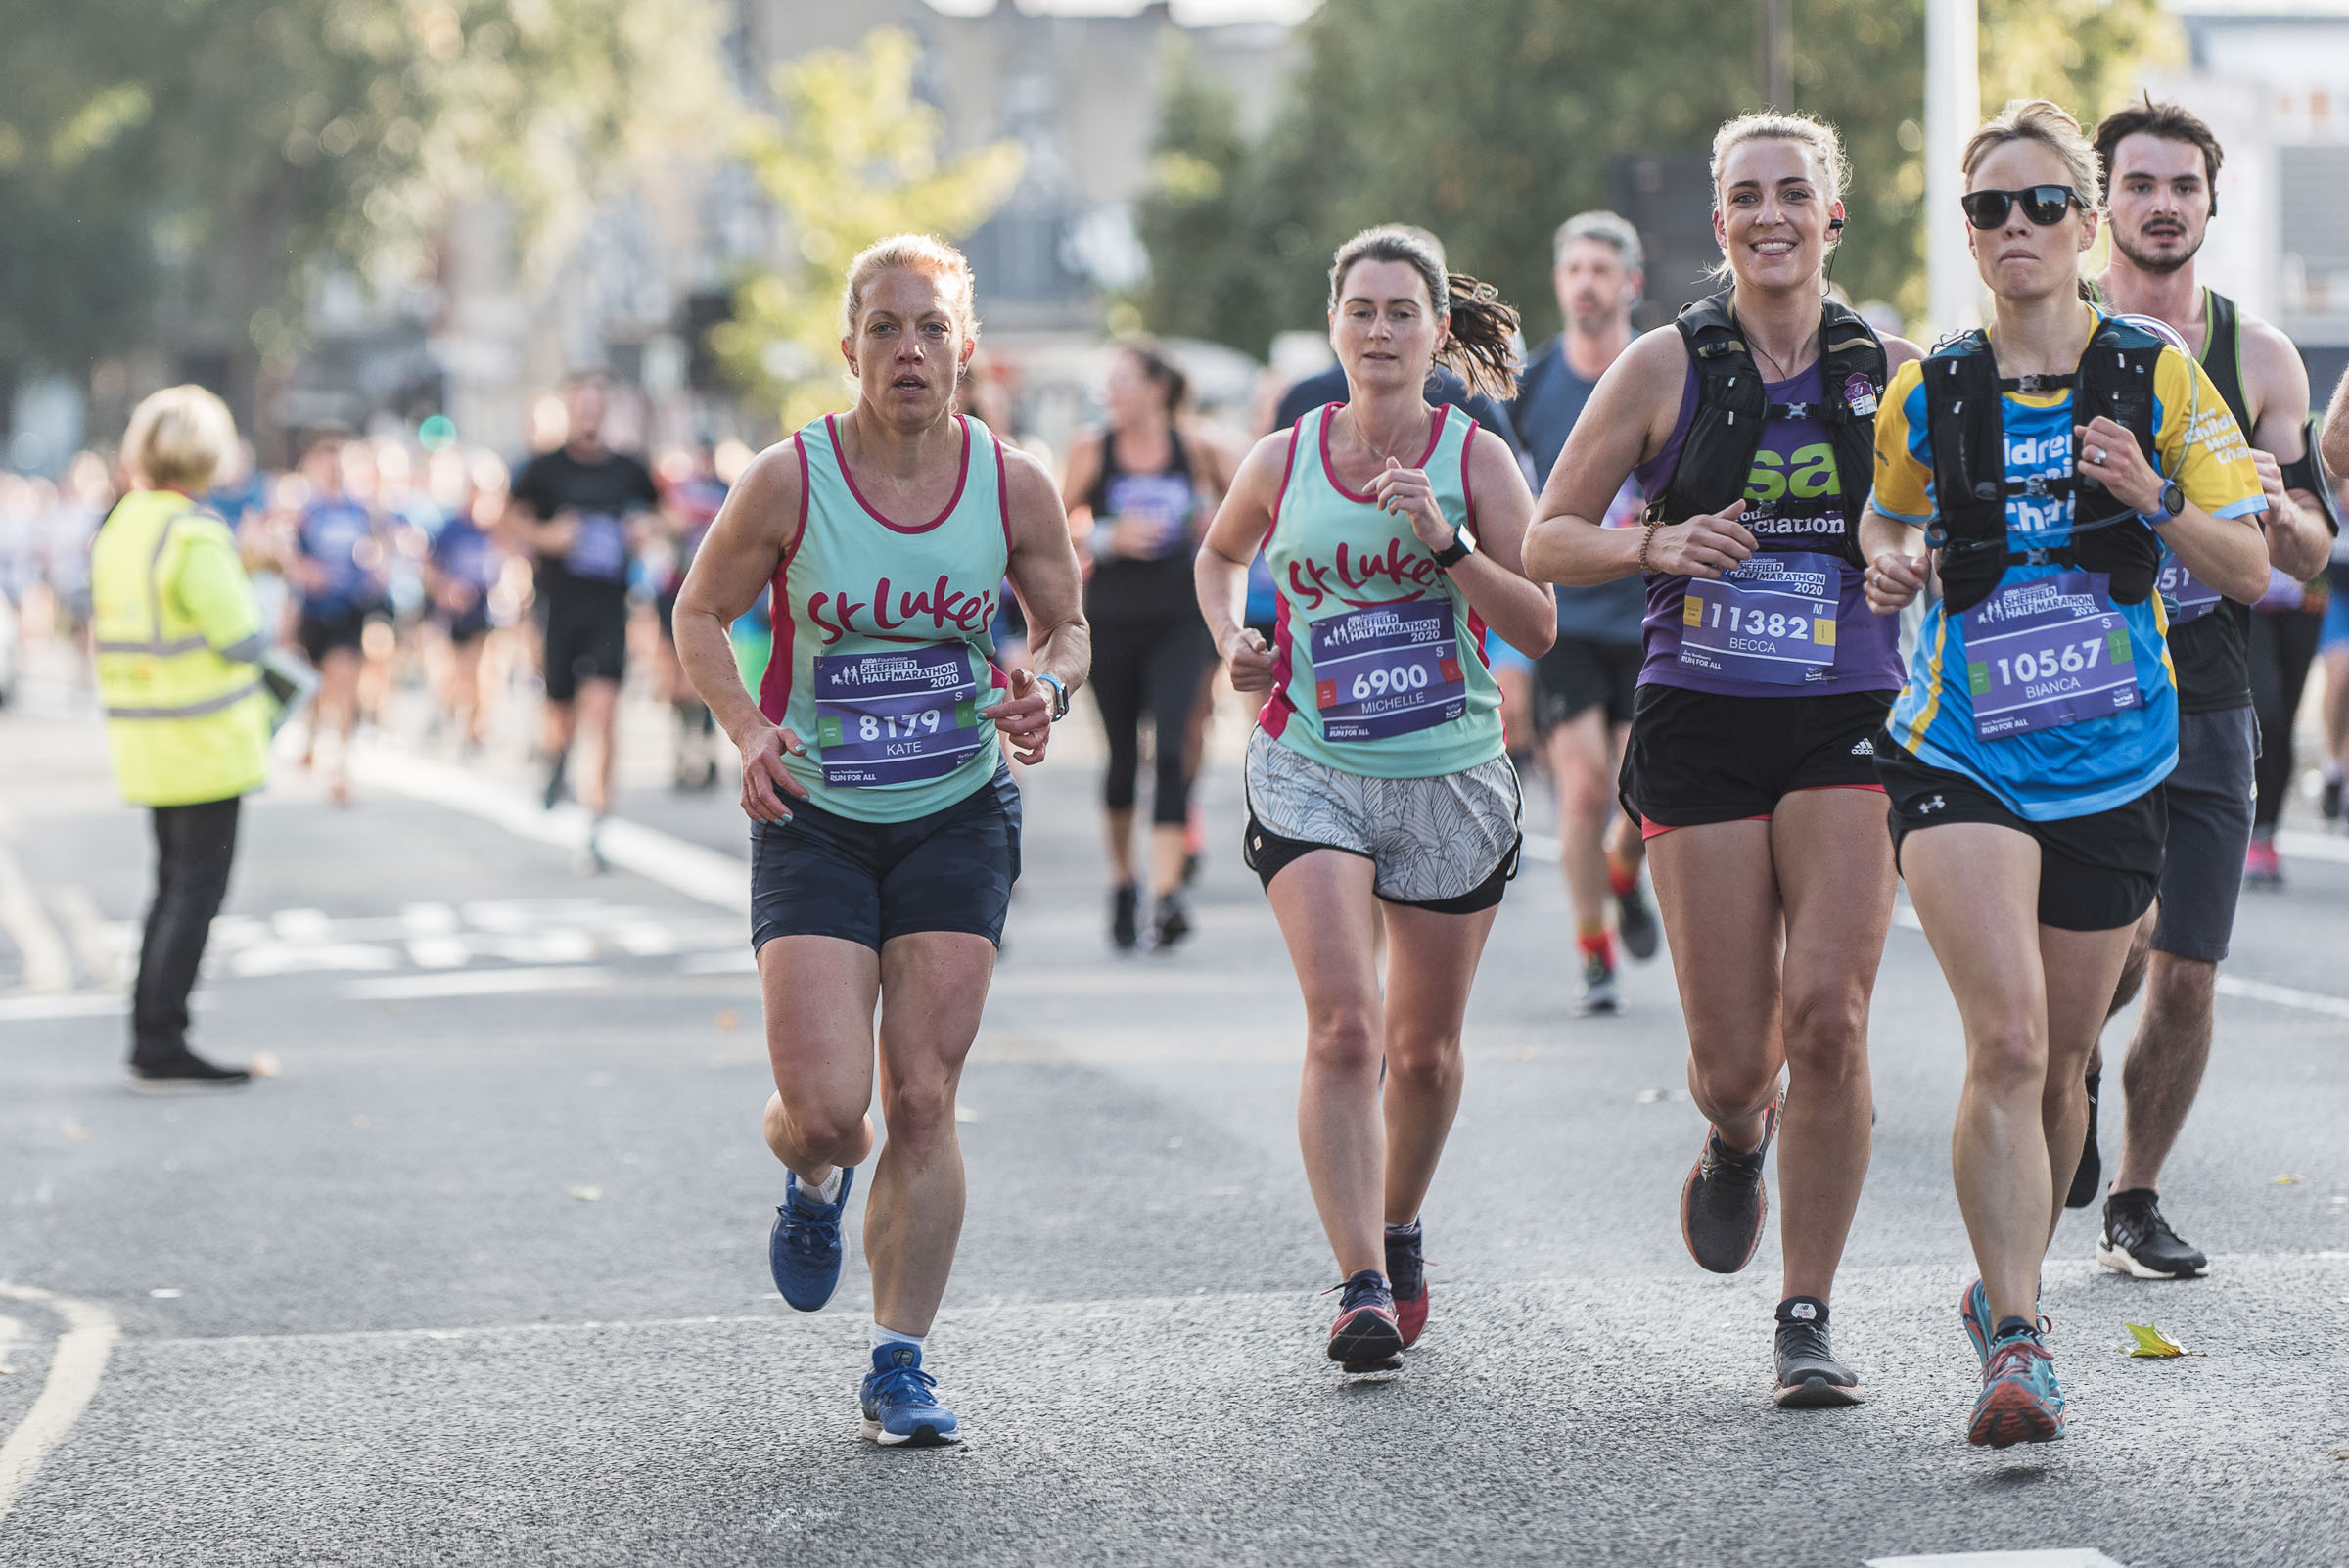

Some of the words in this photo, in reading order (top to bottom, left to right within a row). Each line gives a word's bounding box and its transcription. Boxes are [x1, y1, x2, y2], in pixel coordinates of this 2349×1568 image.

[1289, 558, 1334, 610] St
[1336, 537, 1448, 589] Luke
[1759, 573, 1825, 585] MARATHON
[2153, 567, 2190, 590] 51
[1793, 583, 1823, 595] 2020
[2004, 588, 2055, 606] SHEFFIELD
[808, 591, 866, 645] St
[873, 575, 995, 634] Luke's
[1813, 603, 1823, 615] M
[2006, 605, 2034, 619] HALF
[2036, 595, 2094, 613] MARATHON
[2072, 605, 2100, 617] 2020
[1349, 615, 1397, 630] SHEFFIELD
[1711, 603, 1808, 640] 11382
[2102, 618, 2112, 629] S
[1351, 629, 1376, 642] HALF
[1377, 620, 1439, 635] MARATHON
[1411, 630, 1440, 642] 2020
[1436, 646, 1444, 657] S
[1729, 637, 1776, 653] BECCA
[861, 662, 915, 673] SHEFFIELD
[1681, 656, 1695, 665] RUN
[1998, 638, 2102, 685] 10567
[862, 672, 892, 683] HALF
[893, 664, 956, 680] MARATHON
[931, 674, 959, 688] 2020
[1352, 664, 1428, 699] 6900
[2025, 676, 2081, 699] BIANCA
[955, 691, 963, 701] S
[1361, 692, 1425, 714] MICHELLE
[859, 710, 941, 741] 8179
[1982, 725, 1998, 734] RUN
[1999, 721, 2013, 731] FOR
[2014, 718, 2028, 727] ALL
[887, 741, 922, 755] KATE
